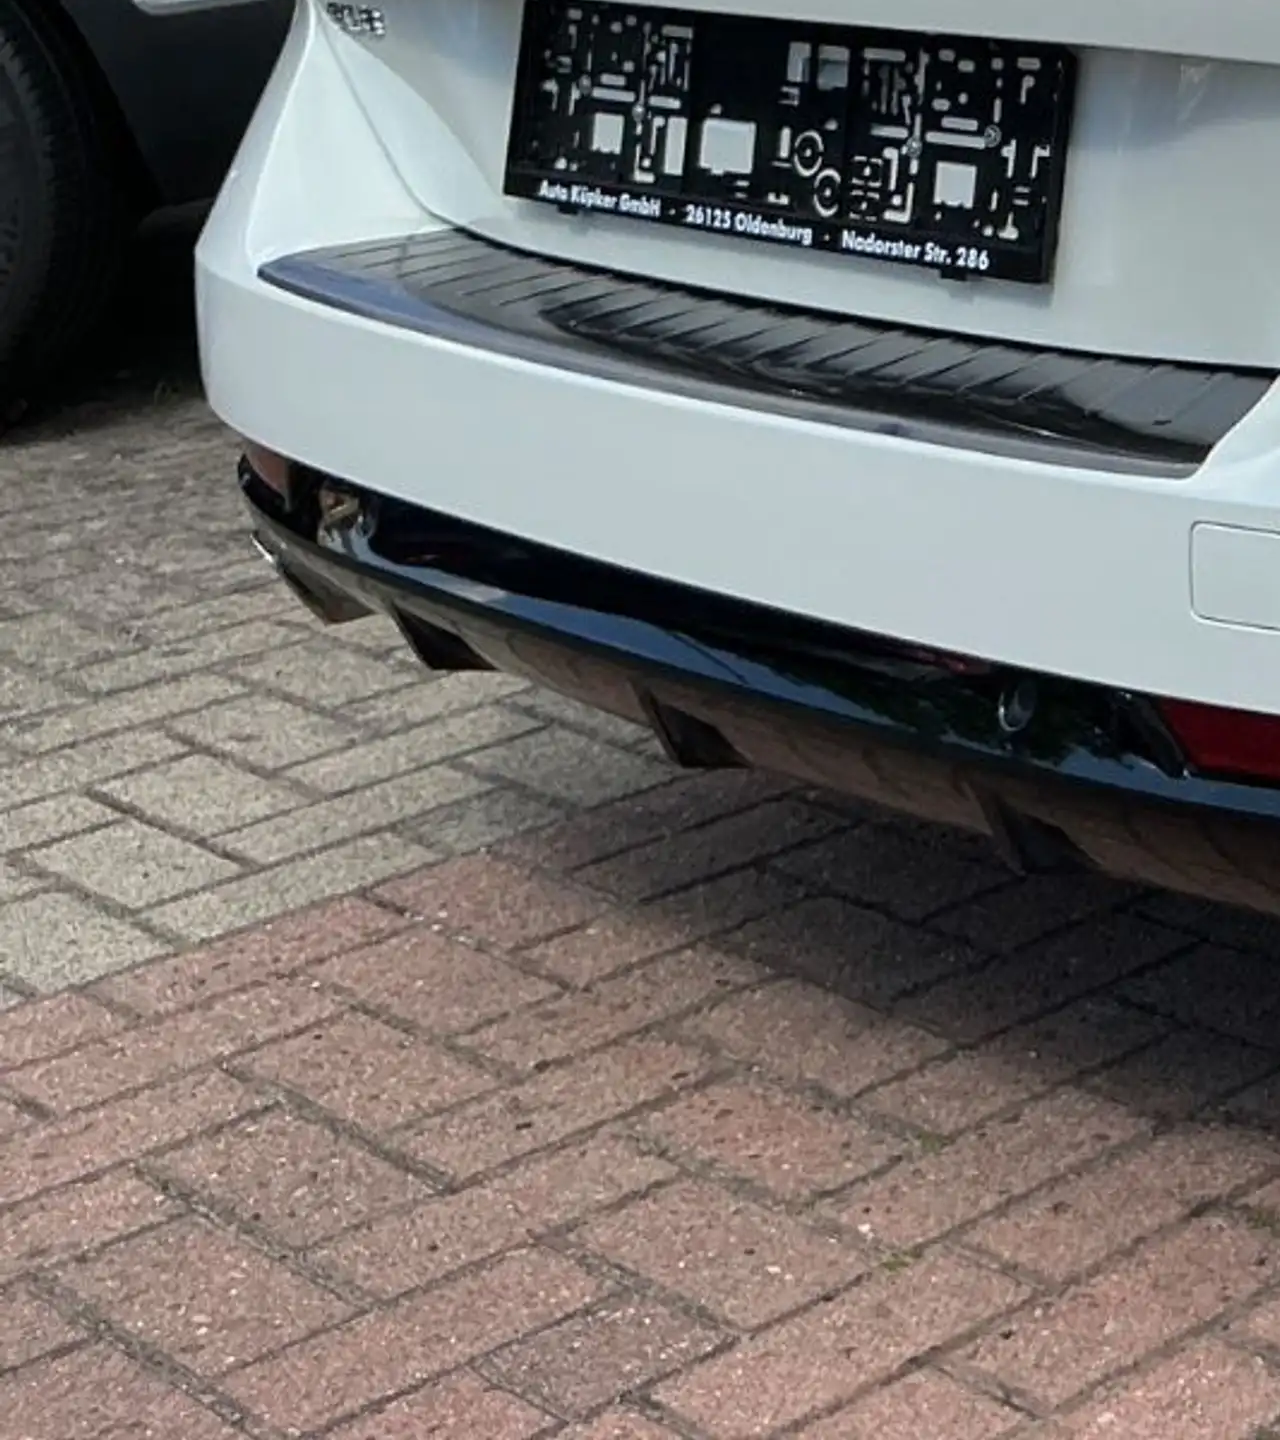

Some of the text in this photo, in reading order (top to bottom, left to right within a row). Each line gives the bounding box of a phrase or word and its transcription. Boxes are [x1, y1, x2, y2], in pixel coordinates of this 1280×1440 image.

[538, 178, 568, 201] Auto
[618, 192, 662, 218] GmbH
[685, 203, 732, 231] 26125
[734, 212, 813, 246] Oldenburg
[842, 228, 923, 262] Nadorster
[923, 241, 952, 266] Str.
[955, 246, 990, 272] 286
